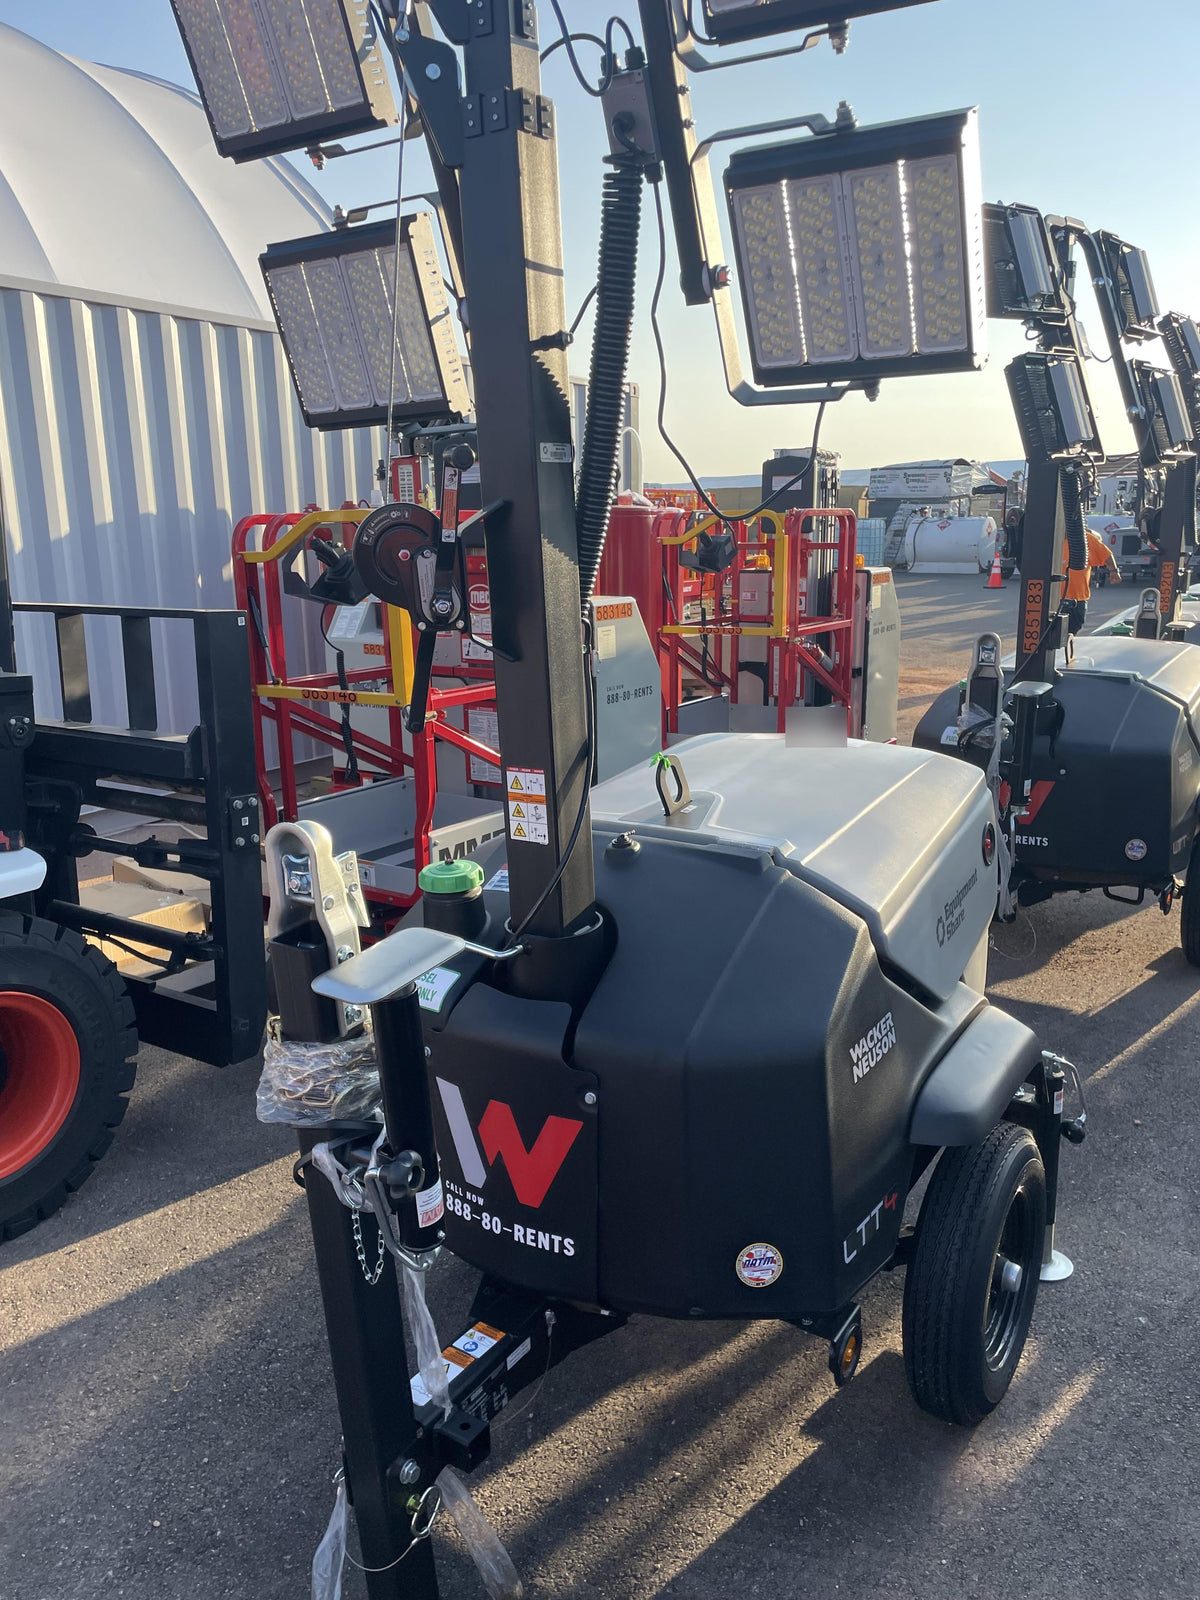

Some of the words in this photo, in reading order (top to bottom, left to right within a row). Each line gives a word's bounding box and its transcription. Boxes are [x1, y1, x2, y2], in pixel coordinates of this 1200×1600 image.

[596, 602, 633, 621] 583148
[1024, 582, 1043, 652] 585183
[606, 685, 654, 705] 888-80-RENTS
[944, 867, 978, 921] Equipment
[946, 908, 966, 942] Share
[849, 1011, 894, 1064] WACKER
[852, 1026, 896, 1084] NEUSON
[445, 1179, 464, 1197] CALL
[465, 1191, 484, 1206] NOW
[446, 1192, 575, 1257] 888-80-RENTS
